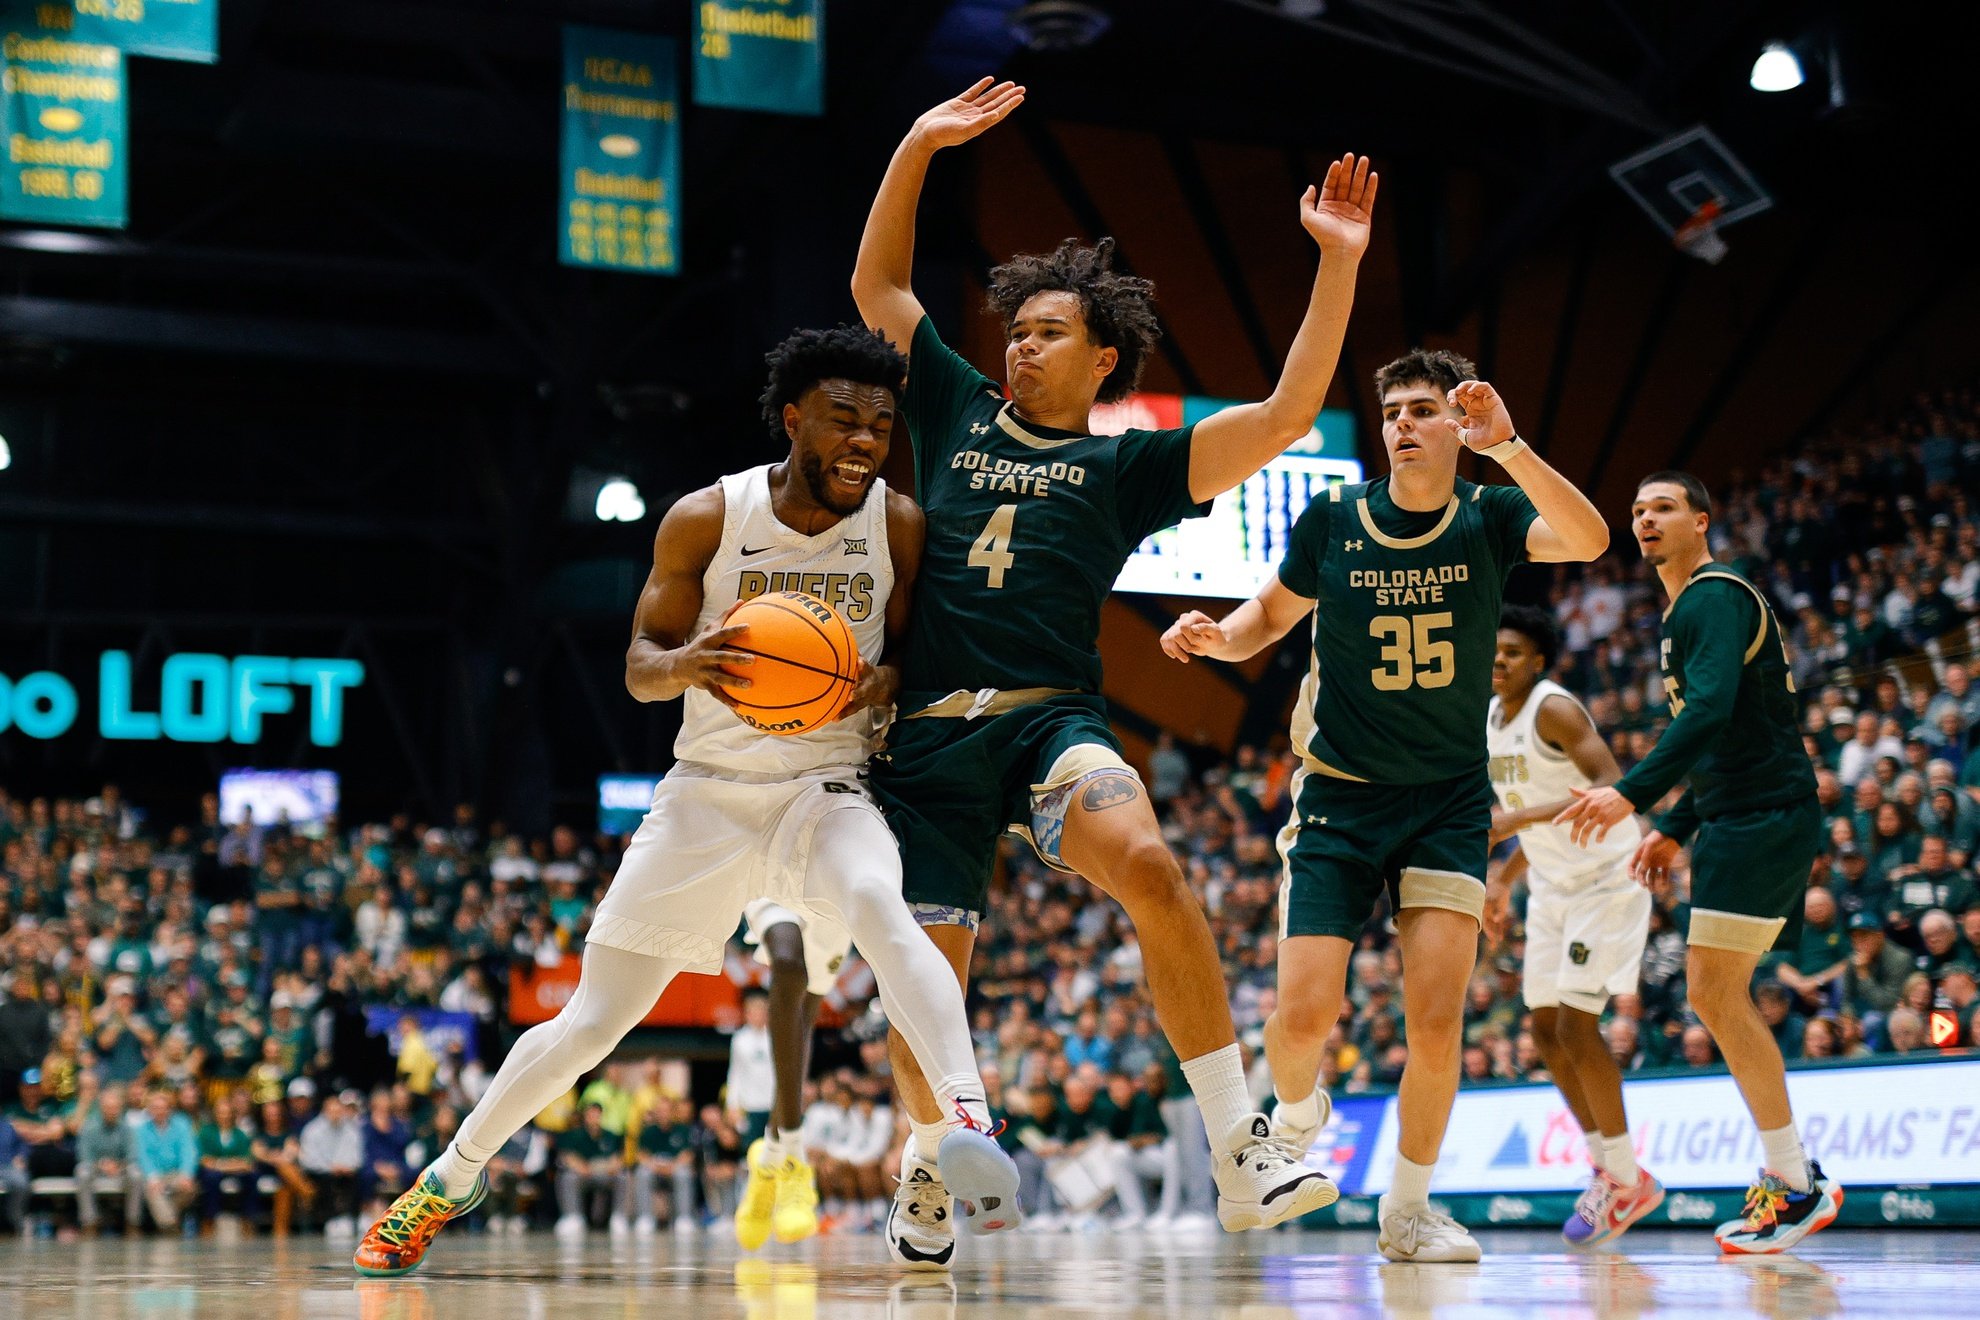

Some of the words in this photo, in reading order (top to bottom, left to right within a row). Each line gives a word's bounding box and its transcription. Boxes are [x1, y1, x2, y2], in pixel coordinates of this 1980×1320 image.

[951, 450, 1086, 486] COLORADO
[969, 472, 1051, 497] STATE
[967, 504, 1018, 589] 4
[1350, 564, 1469, 588] COLORADO
[1376, 585, 1444, 606] STATE
[1369, 611, 1455, 691] 35
[100, 649, 365, 748] LOFT
